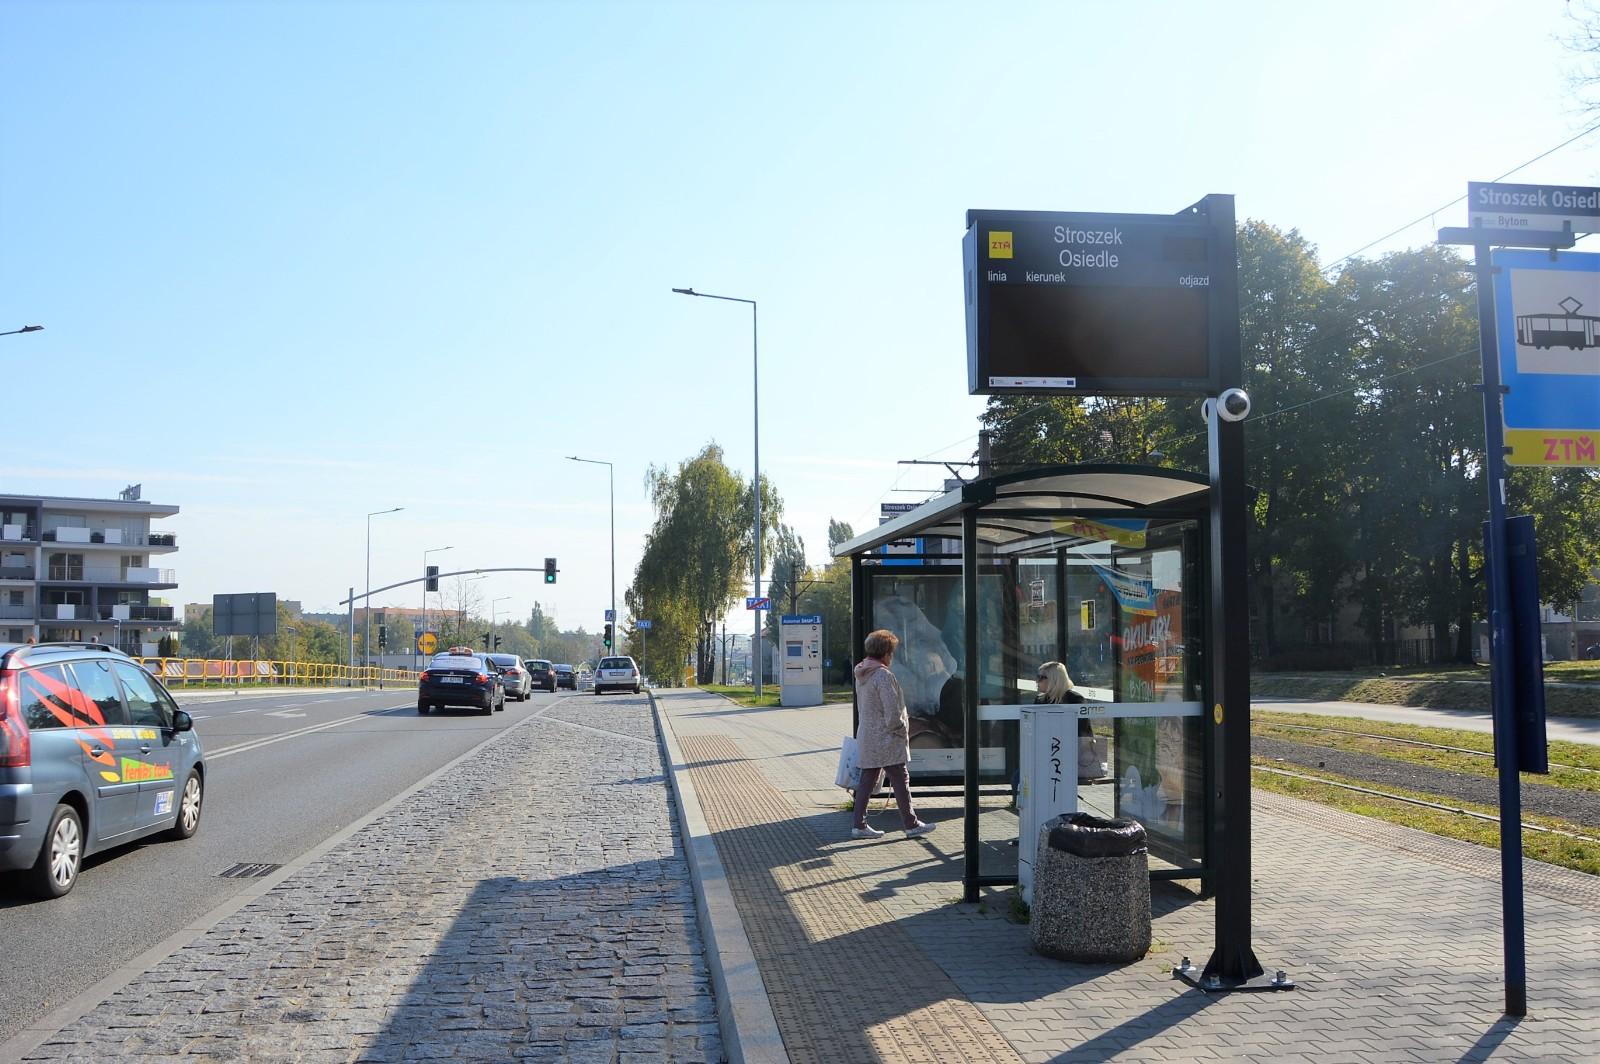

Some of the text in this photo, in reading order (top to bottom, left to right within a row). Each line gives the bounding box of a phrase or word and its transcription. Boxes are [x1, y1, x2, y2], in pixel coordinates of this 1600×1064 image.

[1479, 188, 1548, 207] Stroszek
[1498, 216, 1528, 227] Bytom
[1053, 225, 1123, 246] Stroszek
[1059, 249, 1119, 268] Osiedle
[988, 271, 1066, 283] linia kierunek
[1179, 275, 1210, 288] odjazd
[1543, 435, 1596, 461] ZTM
[747, 599, 770, 609] TAXI
[637, 621, 651, 629] TAXI
